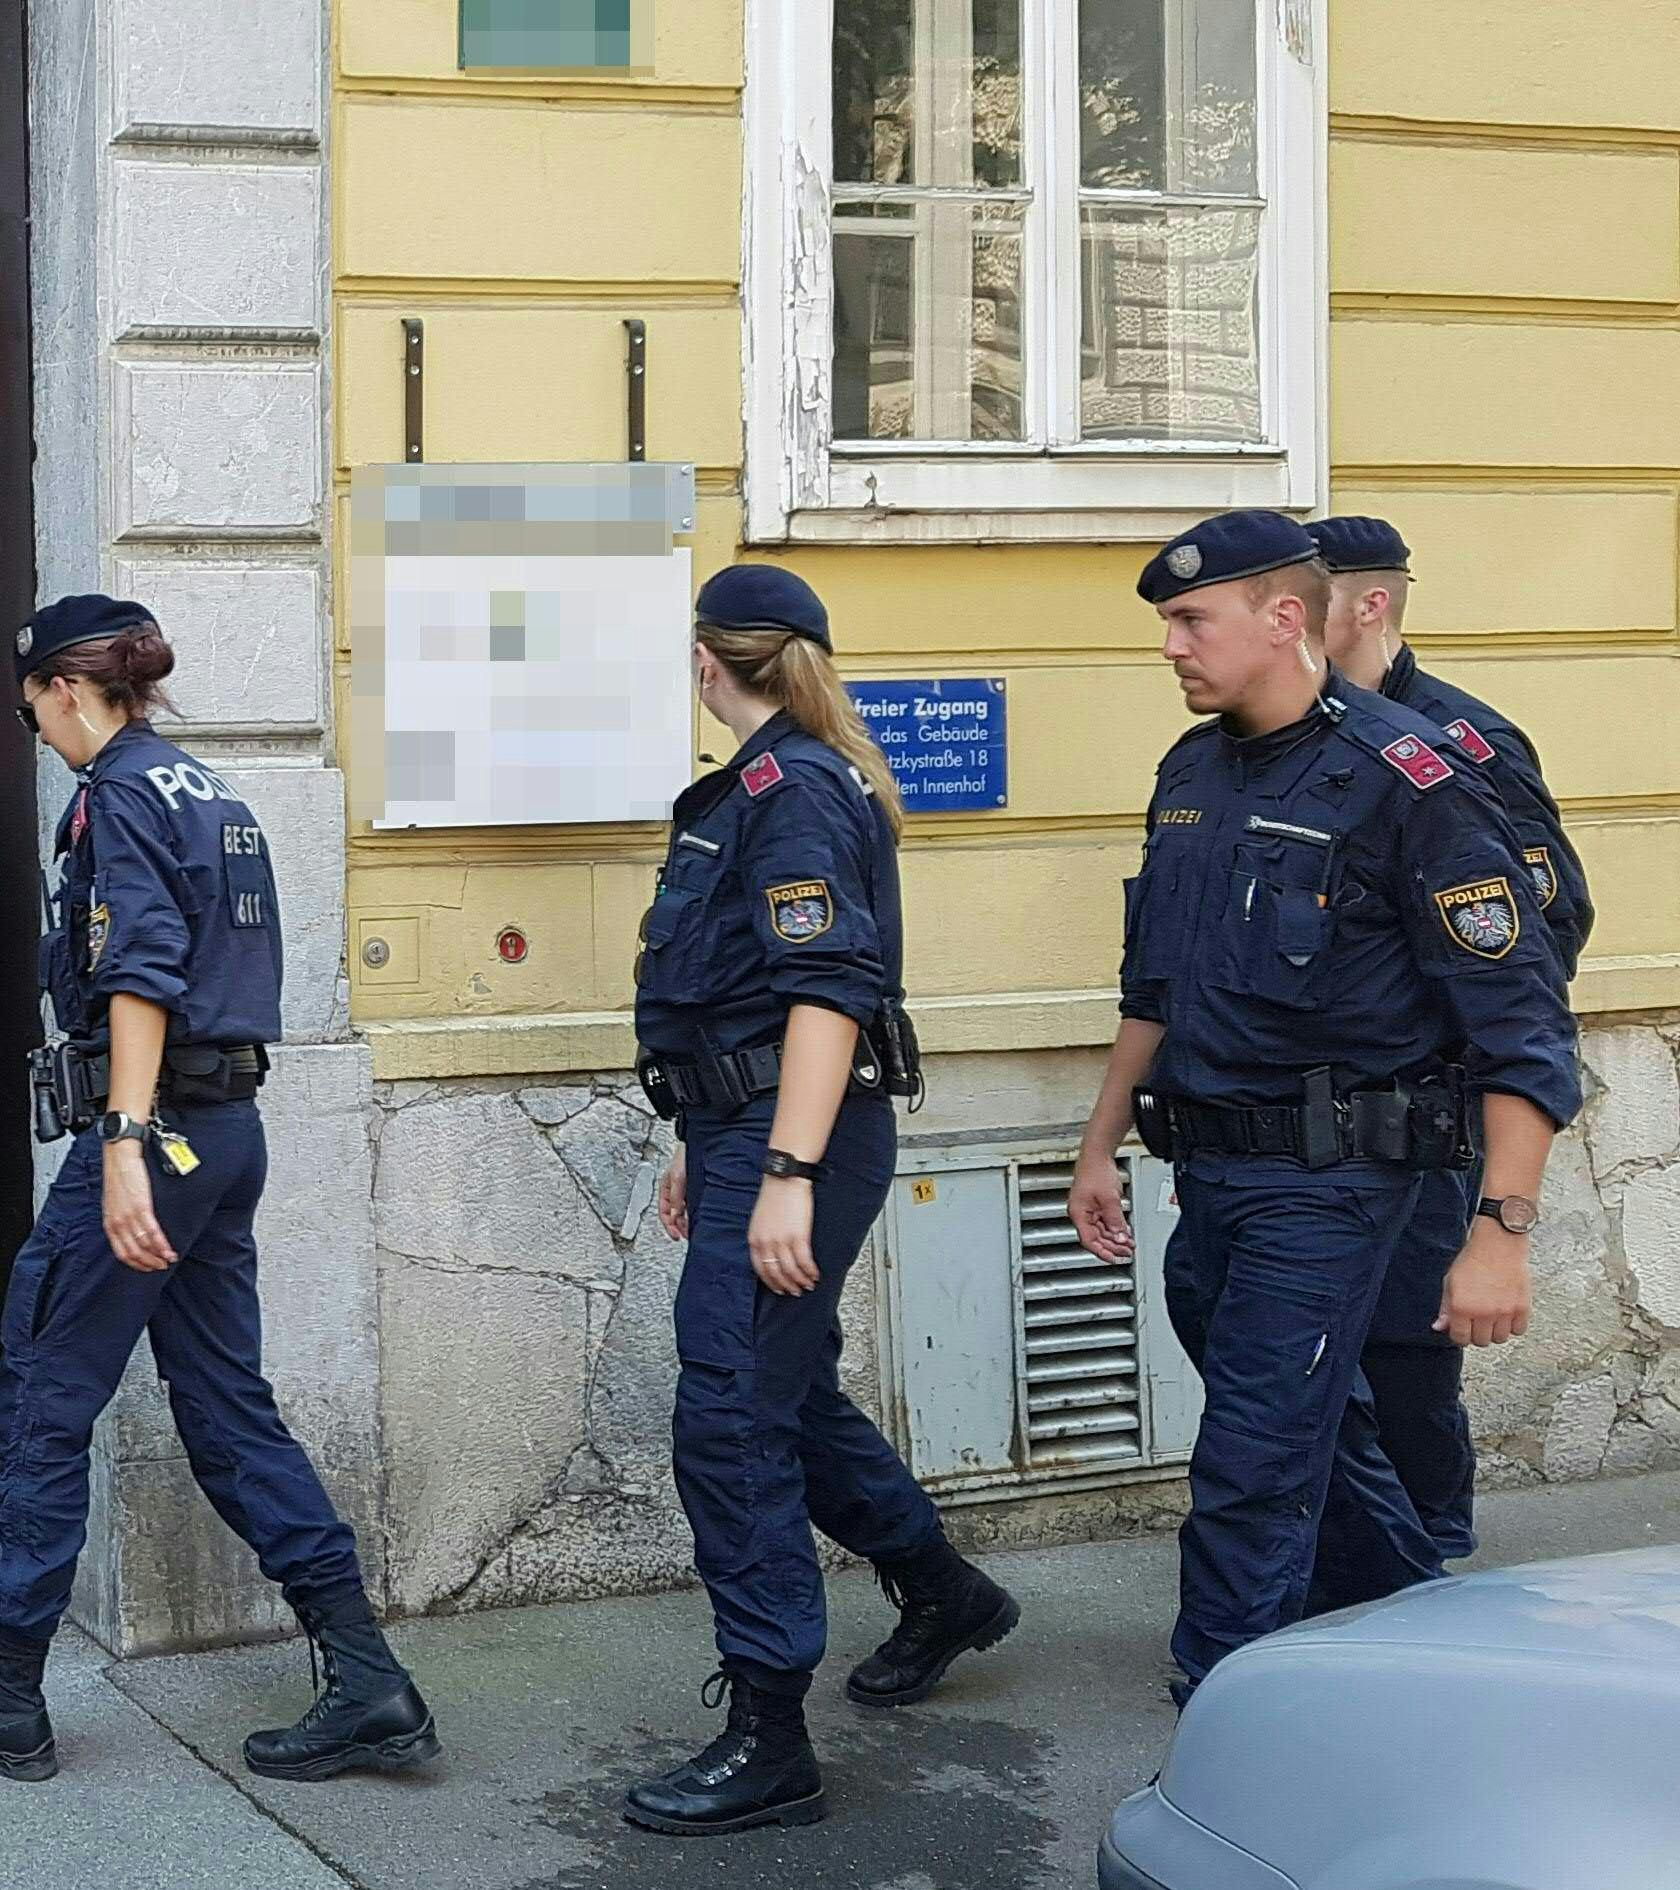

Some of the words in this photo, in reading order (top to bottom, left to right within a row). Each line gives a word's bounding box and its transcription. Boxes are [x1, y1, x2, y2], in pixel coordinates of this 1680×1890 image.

[855, 698, 908, 717] freier
[914, 698, 988, 721] Zugang
[880, 725, 908, 743] das
[918, 723, 989, 742] Gebäude
[888, 749, 963, 773] tzkystraße
[969, 749, 988, 767] 18
[923, 774, 986, 794] Innenhof
[773, 885, 824, 905] POLIZEI
[1442, 883, 1504, 908] POLIZEI
[237, 893, 261, 924] 611
